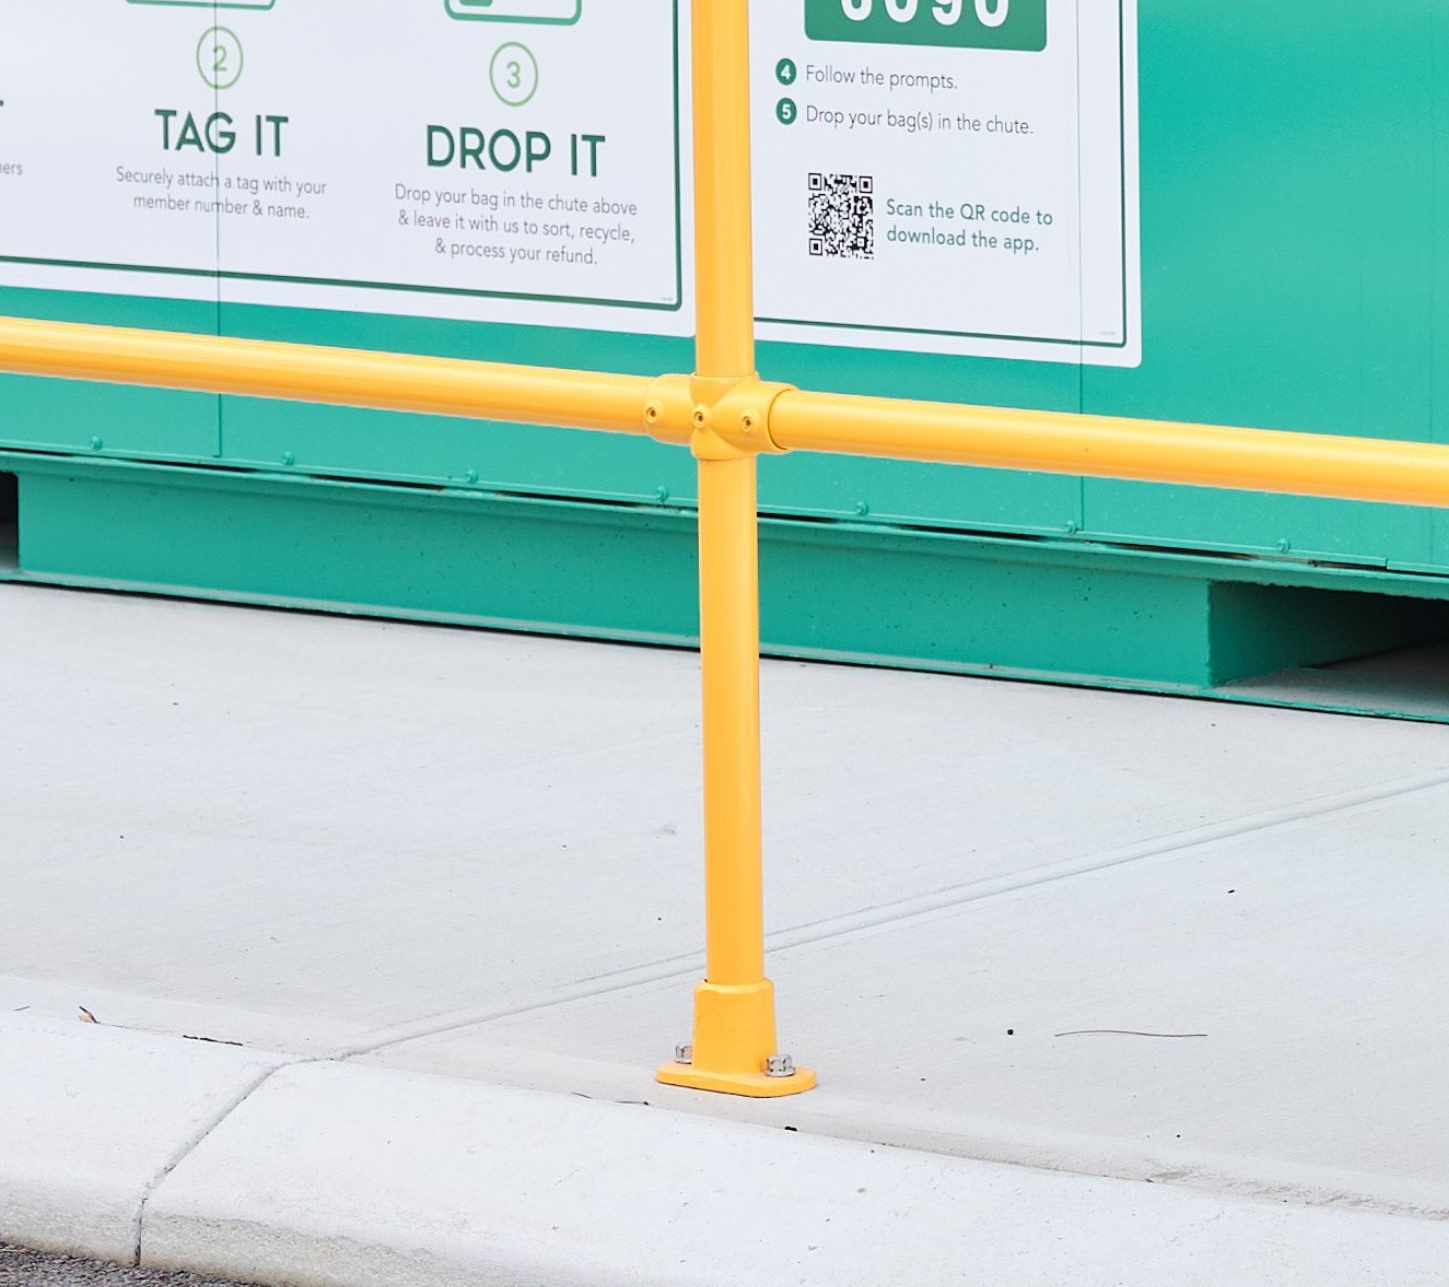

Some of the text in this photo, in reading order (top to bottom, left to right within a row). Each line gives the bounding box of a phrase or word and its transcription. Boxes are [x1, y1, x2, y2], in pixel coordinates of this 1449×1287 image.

[807, 65, 855, 83] Follow
[860, 67, 884, 85] the
[890, 74, 957, 93] prompts.
[155, 109, 288, 157] TAG IT
[807, 105, 844, 128] Drop
[849, 113, 882, 129] your
[887, 109, 932, 133] bag(s)
[939, 113, 951, 129] in
[957, 113, 981, 131] the
[986, 115, 1033, 134] chute.
[427, 125, 605, 177] DROP IT
[395, 183, 637, 215] Drop your bag in the chute above
[887, 198, 1052, 225] Scan the QR code to
[887, 225, 1039, 255] download the app.
